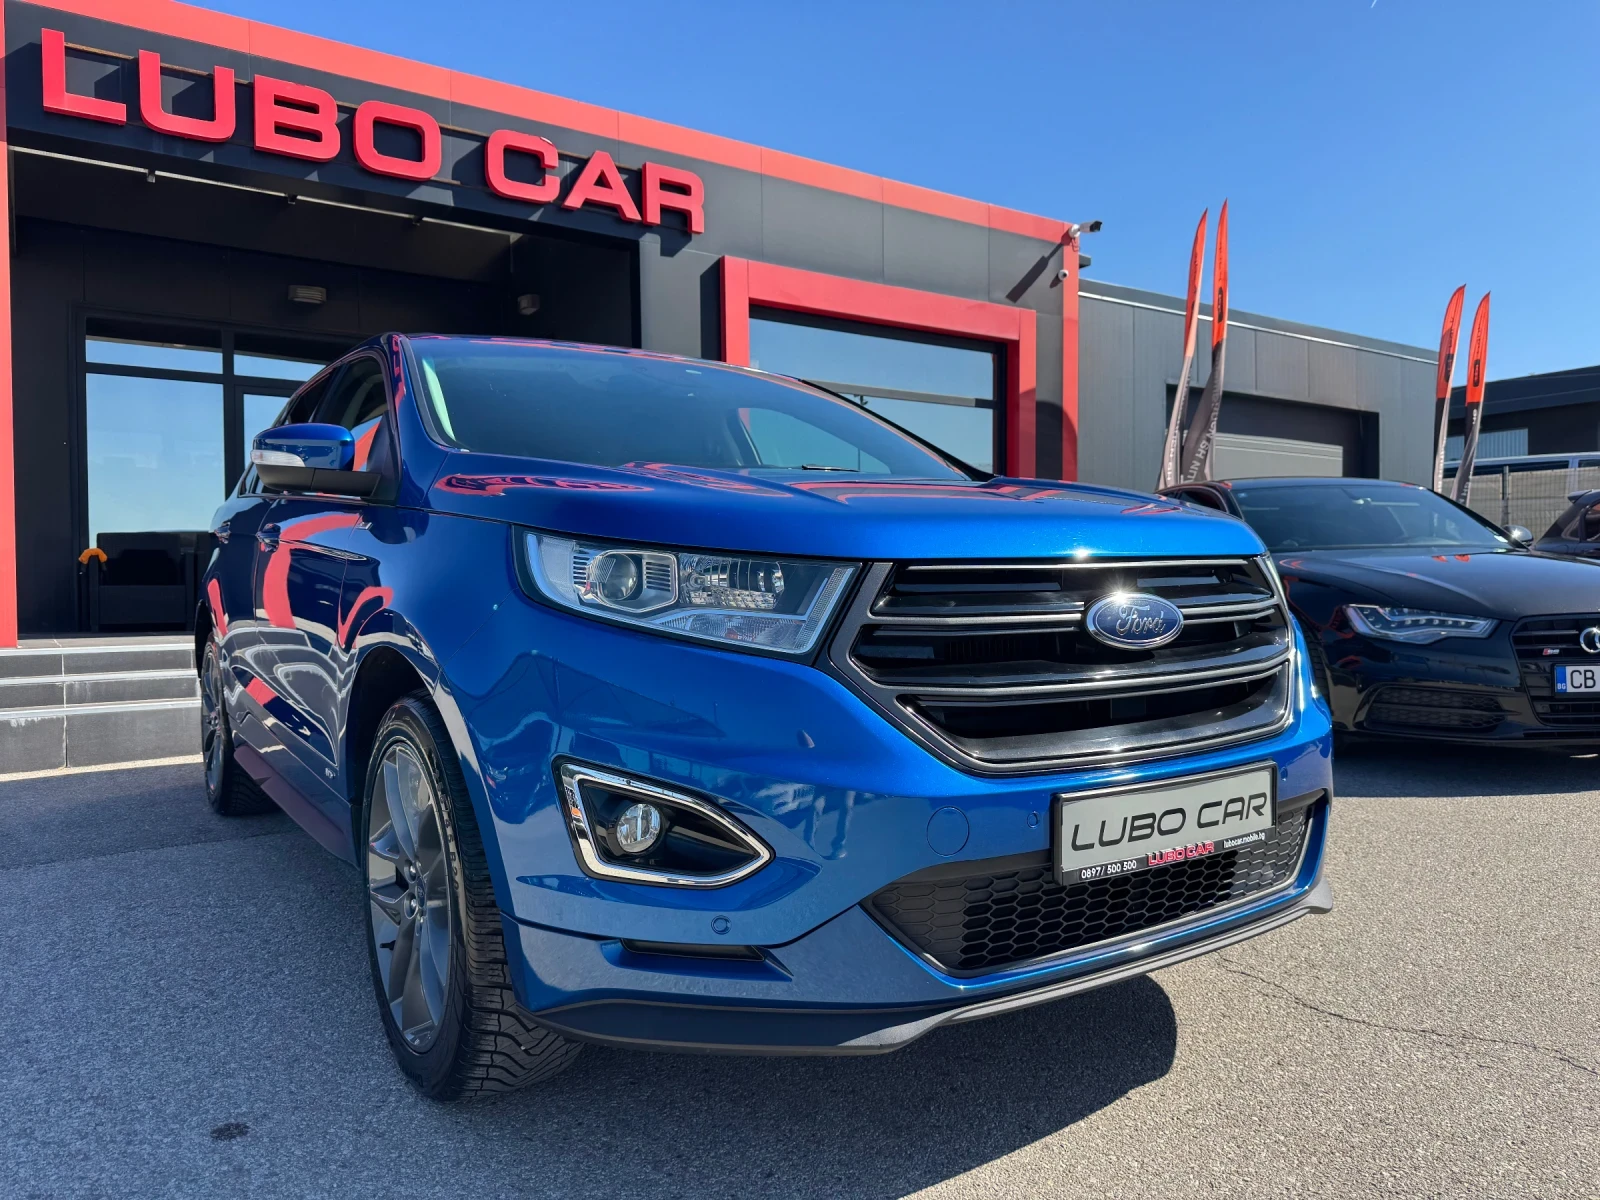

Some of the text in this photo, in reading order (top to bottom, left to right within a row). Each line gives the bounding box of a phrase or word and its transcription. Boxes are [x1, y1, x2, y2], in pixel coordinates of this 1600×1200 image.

[41, 27, 705, 234] LUBO CAR
[1115, 604, 1166, 635] Ford
[1071, 792, 1267, 852] LUBO CAR
[1147, 840, 1215, 866] LUBO CAR
[1223, 831, 1266, 849] lubocar.mobile.bg
[1081, 860, 1137, 879] 0897/ 500 500
